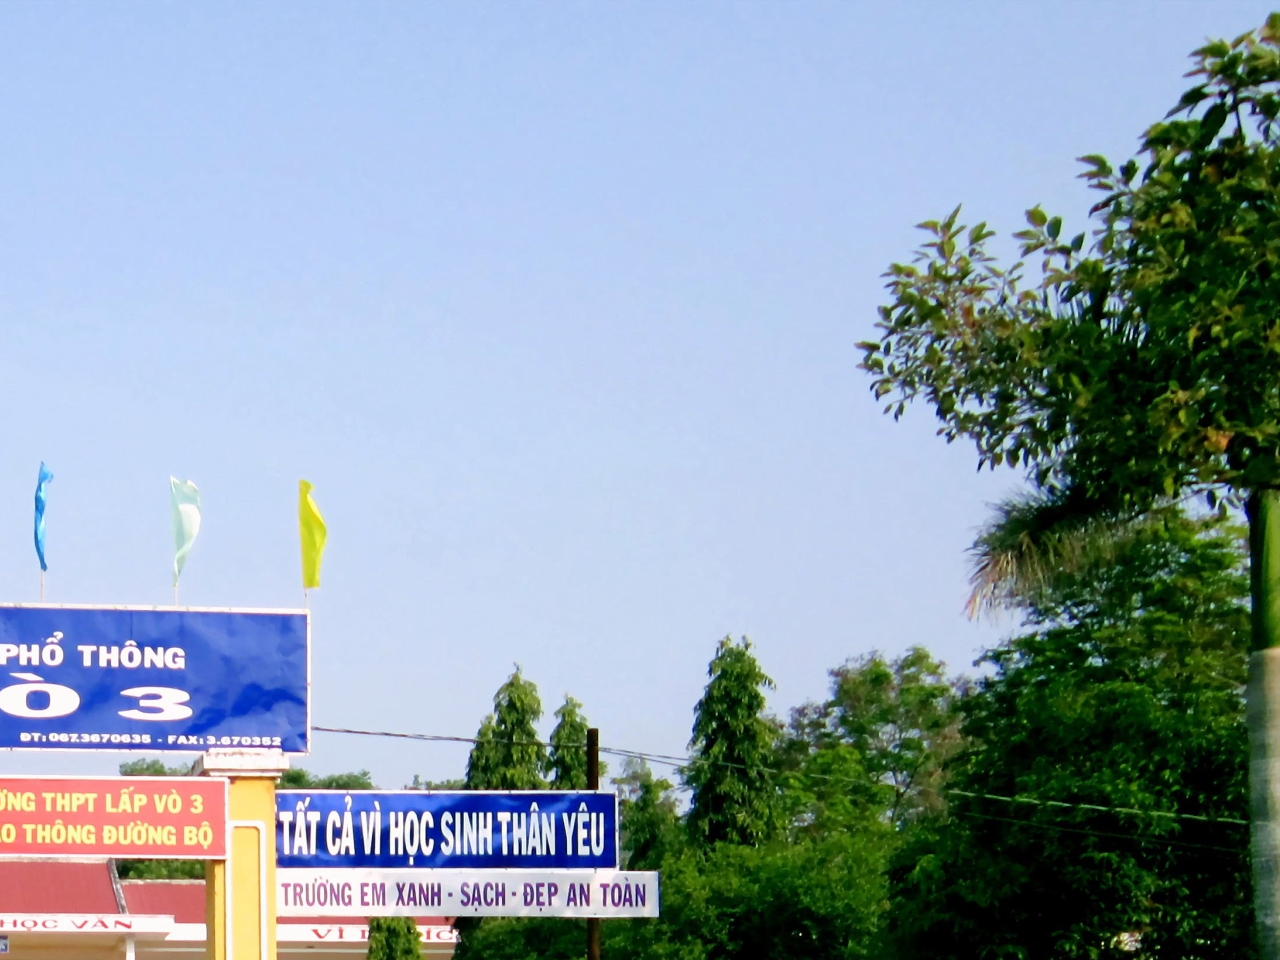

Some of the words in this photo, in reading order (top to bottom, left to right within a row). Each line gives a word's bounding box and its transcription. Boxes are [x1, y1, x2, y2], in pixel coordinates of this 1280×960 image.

[77, 640, 186, 670] THÔNG
[117, 686, 194, 722] 3
[42, 792, 98, 813] THPT
[105, 786, 148, 814] LẤP
[153, 789, 182, 814] VÒ
[190, 794, 203, 814] 3
[22, 820, 96, 845] THÔNG
[103, 821, 176, 846] ĐƯỜNG
[184, 821, 213, 849] BỘ
[279, 796, 321, 856] TẤT
[325, 795, 355, 856] CẢ
[360, 800, 381, 856] VÌ
[389, 812, 434, 866] HỌC
[440, 811, 493, 857] SINH
[497, 802, 556, 856] THÂN
[562, 802, 605, 856] YÊU
[281, 876, 352, 907] TRƯỜNG
[360, 882, 386, 907] EM
[395, 882, 442, 908] XANH
[460, 882, 506, 912] SẠCH
[522, 883, 558, 912] ĐẸP
[567, 883, 590, 908] AN
[599, 876, 646, 908] TOÀN
[0, 919, 58, 932] HỌC
[71, 916, 132, 929] VĂN
